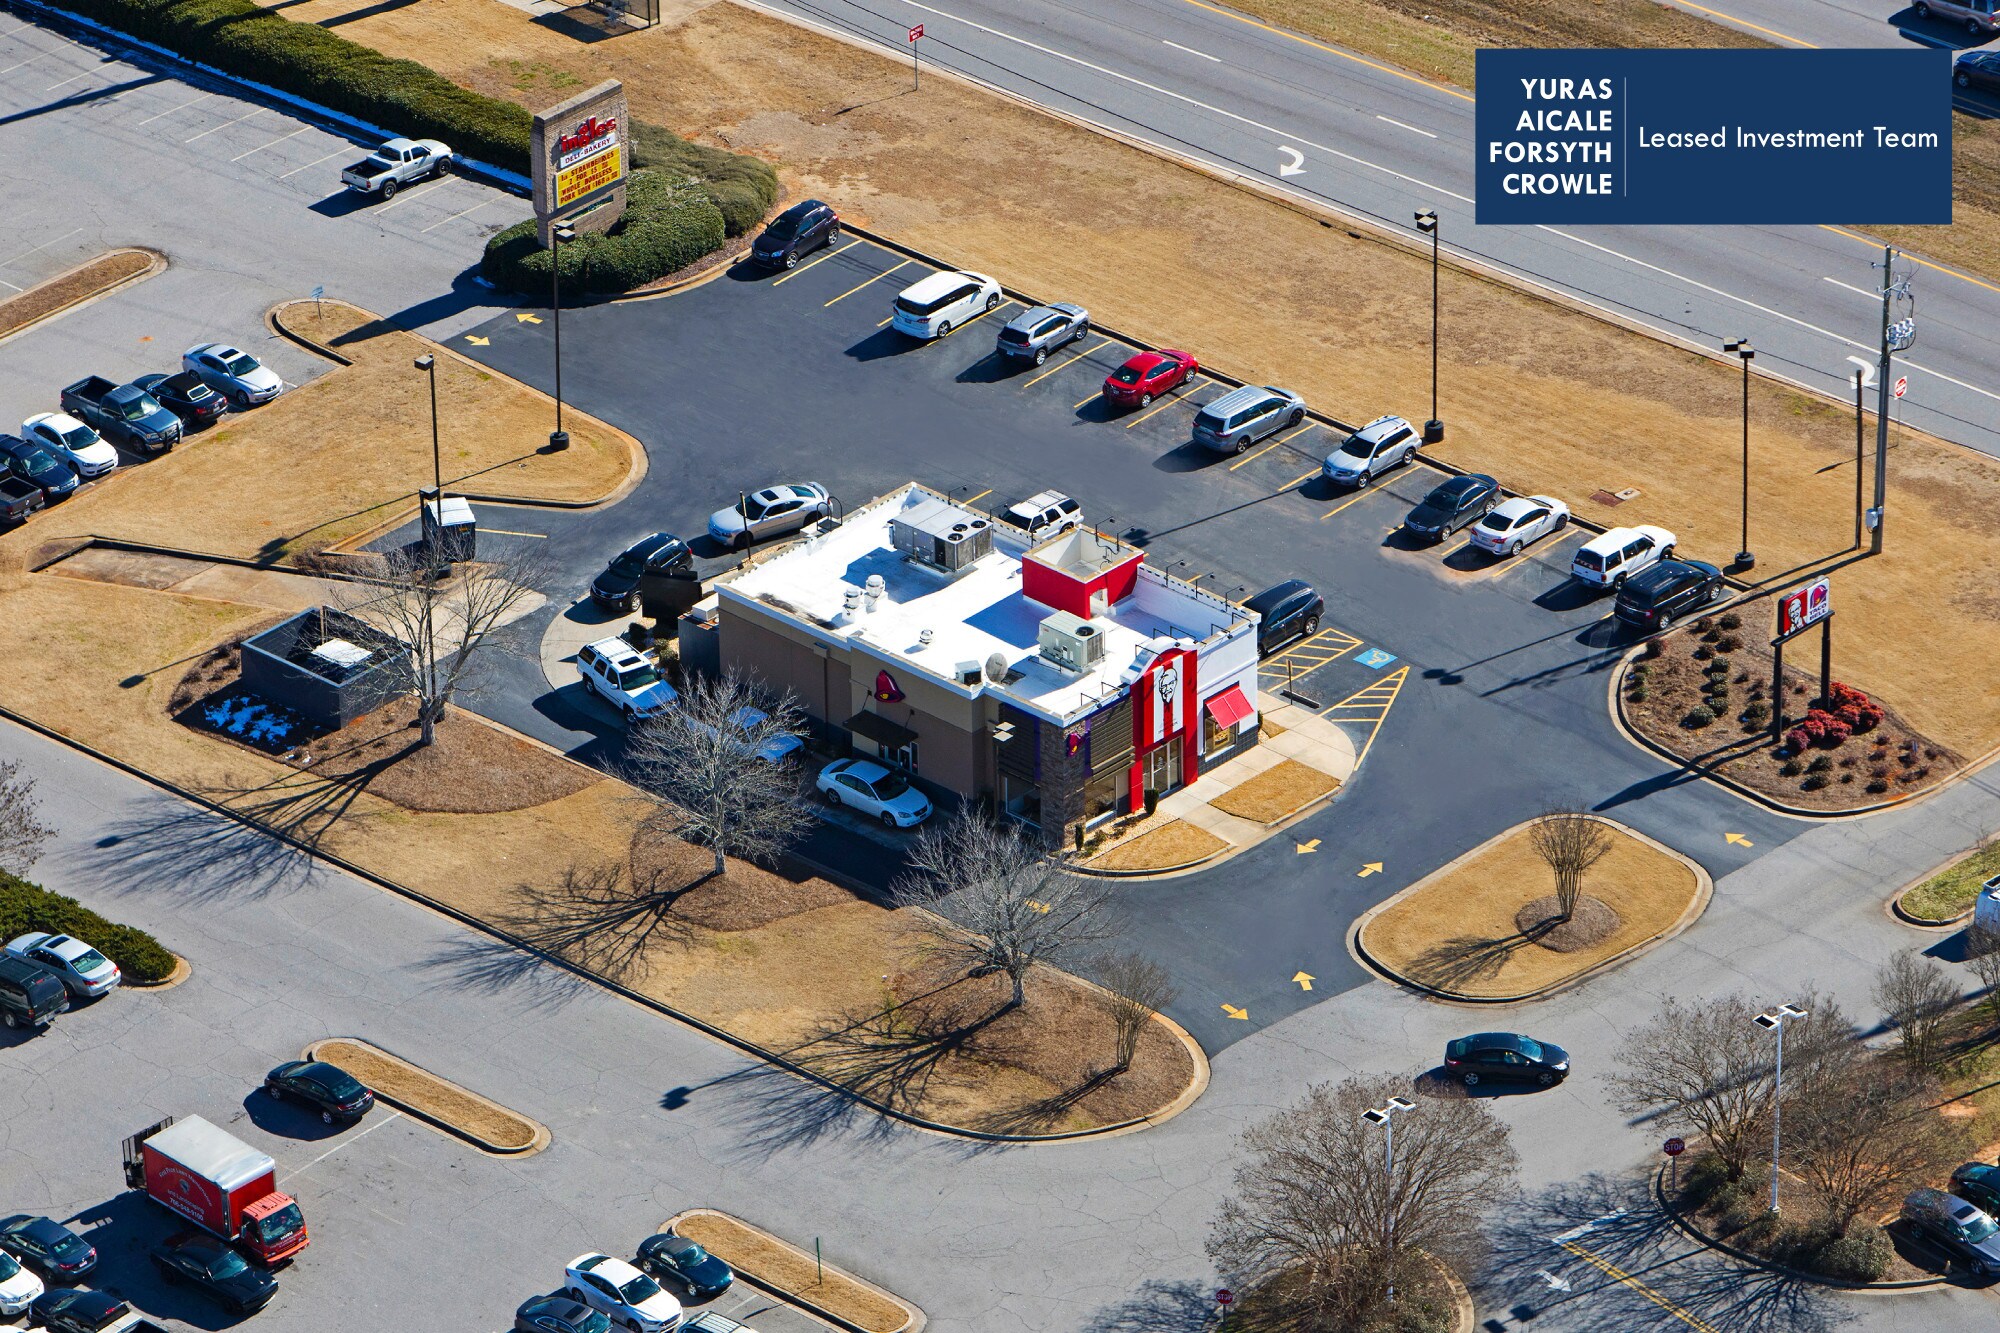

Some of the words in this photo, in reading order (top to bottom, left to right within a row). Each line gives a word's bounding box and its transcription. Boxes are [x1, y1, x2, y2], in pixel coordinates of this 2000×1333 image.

[561, 115, 617, 153] ingles
[565, 137, 611, 164] DELI-BAKERY
[561, 181, 581, 195] WHOLE
[584, 166, 613, 185] BONELESS
[576, 172, 588, 181] FOR
[560, 191, 575, 204] PORK
[1809, 603, 1827, 615] TACO
[1809, 609, 1827, 621] BELL
[1665, 1142, 1684, 1152] STOP
